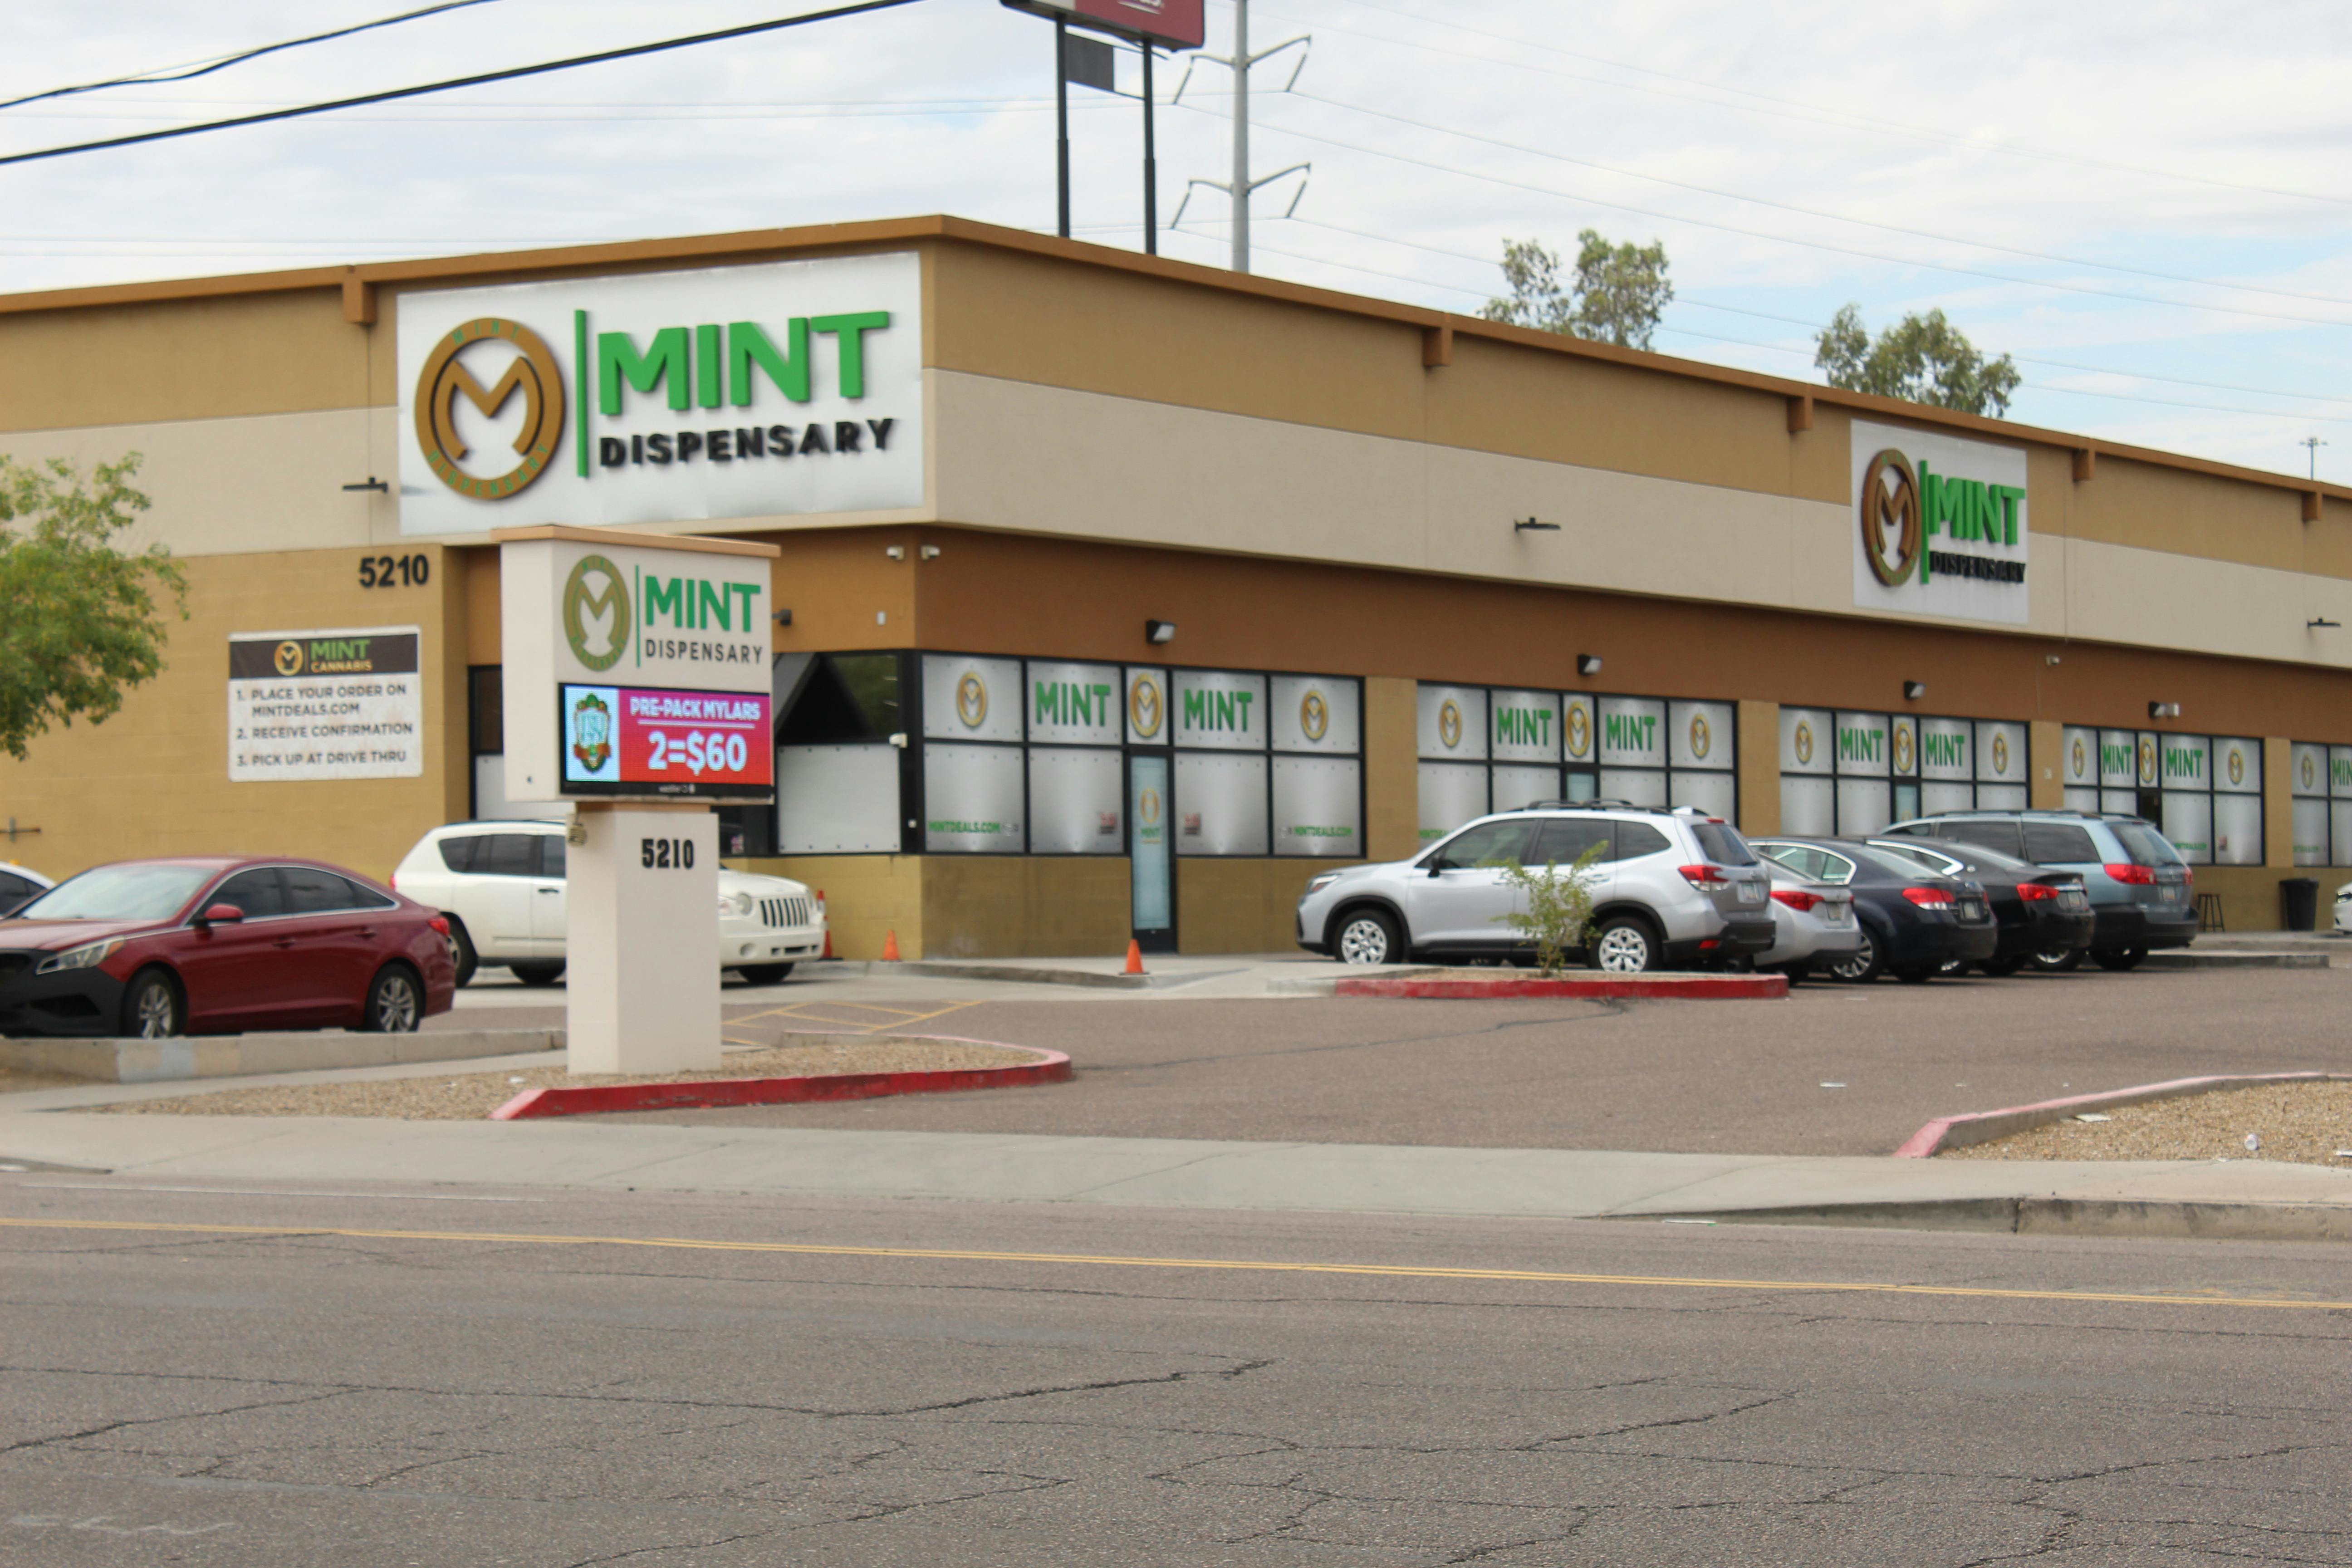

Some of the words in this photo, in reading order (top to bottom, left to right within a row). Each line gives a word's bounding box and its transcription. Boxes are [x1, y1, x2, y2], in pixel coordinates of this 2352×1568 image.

[598, 311, 890, 416] MINT
[599, 418, 895, 469] DISPENSARY
[1928, 474, 2026, 546] MINT
[359, 554, 429, 588] 5210
[1929, 550, 2026, 584] DISPENSARY
[645, 575, 762, 633] MINT
[311, 639, 371, 661] MINT
[311, 659, 372, 673] CANNABIS
[646, 639, 763, 664] DISPENSARY
[252, 689, 294, 700] PLACE
[298, 687, 333, 699] YOUR
[338, 685, 382, 697] ORDER
[387, 684, 406, 695] ON
[630, 696, 702, 719] PRE-PACK
[704, 700, 761, 721] MYLARS
[1035, 681, 1111, 726] MINT
[252, 703, 360, 717] MINTDEALS.COM
[1184, 689, 1254, 732] MINT
[1496, 707, 1553, 746] MINT
[237, 728, 247, 740] 2.
[252, 726, 308, 739] RECEIVE
[312, 723, 413, 737] CONFIRMATION
[1606, 714, 1656, 752] MINT
[1840, 727, 1884, 762] MINT
[252, 754, 282, 766] PICK
[285, 753, 303, 765] UP
[307, 752, 323, 764] AT
[327, 751, 367, 764] DRIVE
[371, 750, 407, 763] THRU
[647, 730, 748, 776] 2=$60
[1925, 733, 1965, 767] MINT
[2102, 744, 2132, 774] MINT
[2166, 747, 2204, 778] MINT
[2331, 759, 2352, 786] MIN
[642, 838, 694, 870] 5210
